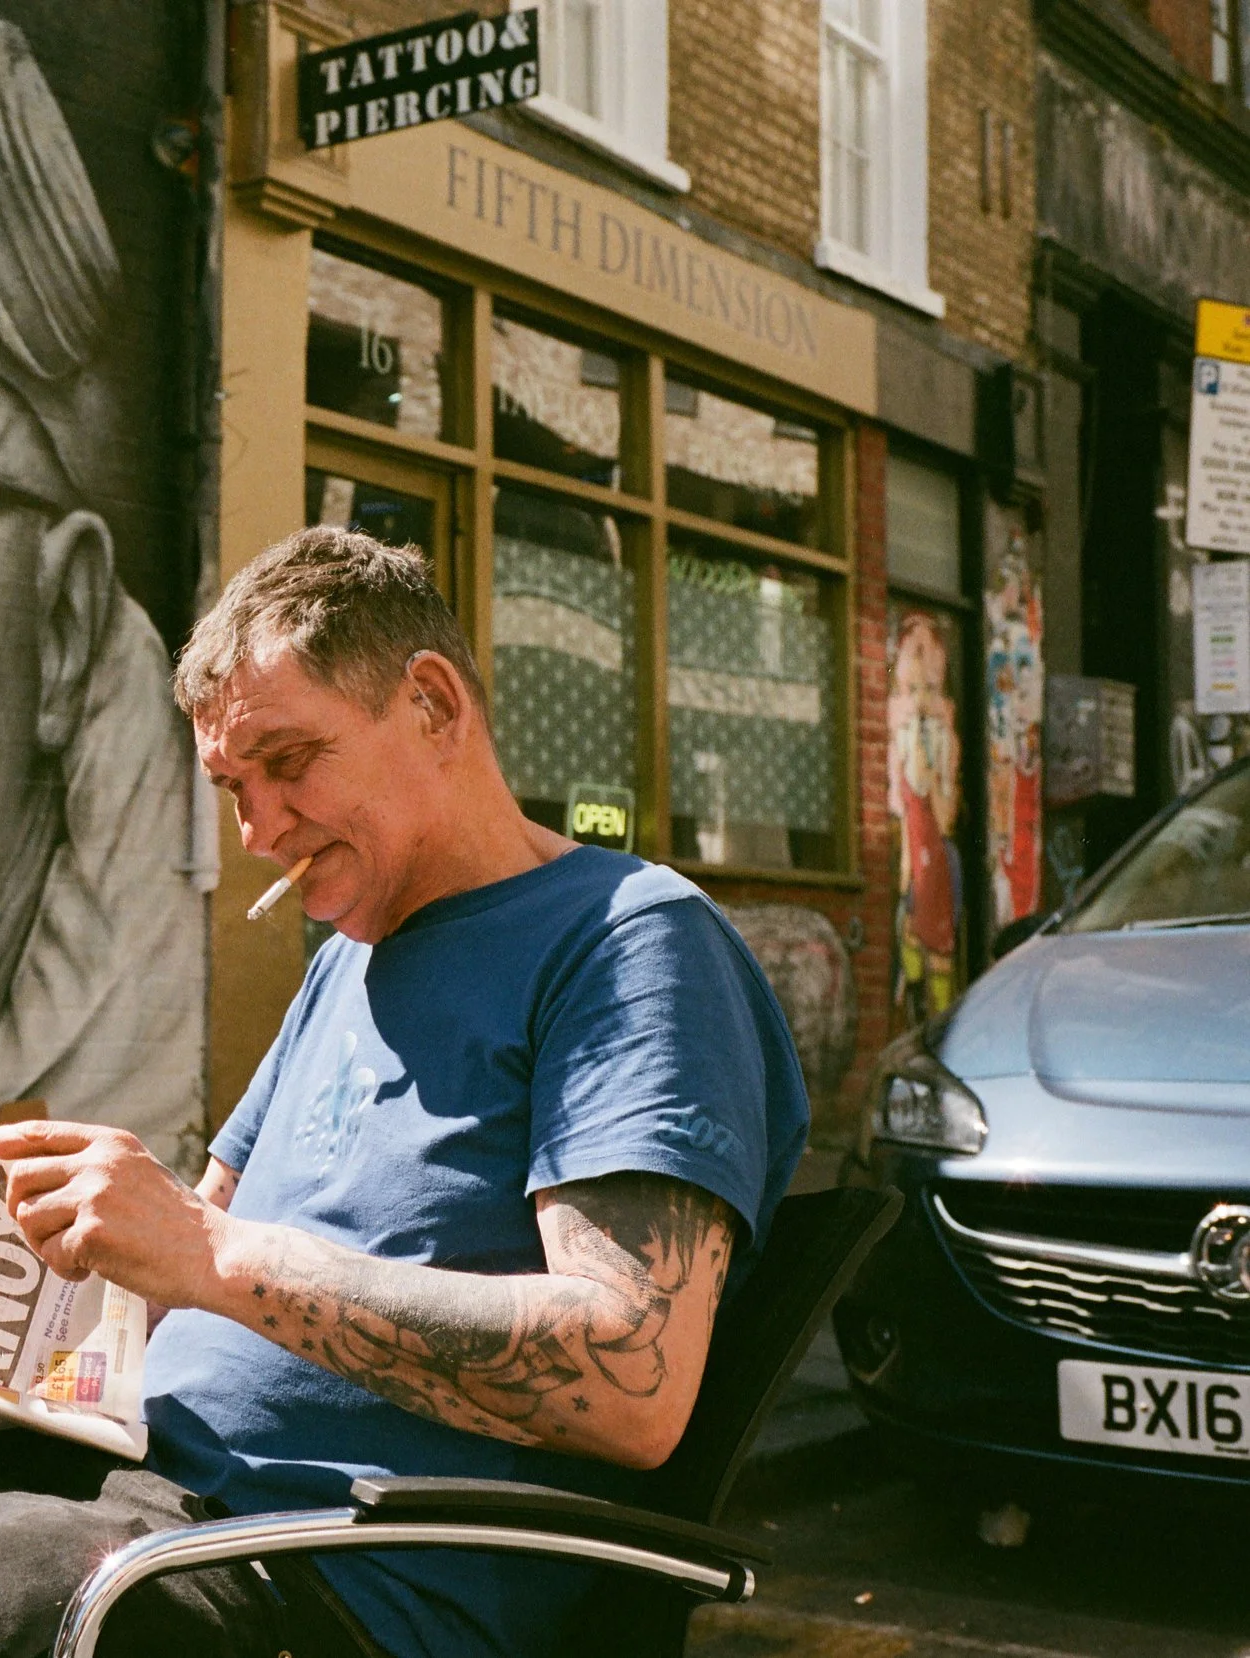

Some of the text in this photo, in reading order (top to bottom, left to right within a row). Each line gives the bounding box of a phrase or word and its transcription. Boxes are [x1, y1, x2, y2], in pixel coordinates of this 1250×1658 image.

[314, 60, 538, 146] PIERCING
[447, 143, 818, 358] FIFTH DIMENSION
[359, 326, 394, 375] 16
[572, 802, 627, 837] OPEN
[44, 1303, 61, 1339] Need
[55, 1317, 70, 1342] See
[52, 1359, 66, 1392] £1.65
[1102, 1373, 1243, 1444] BX16
